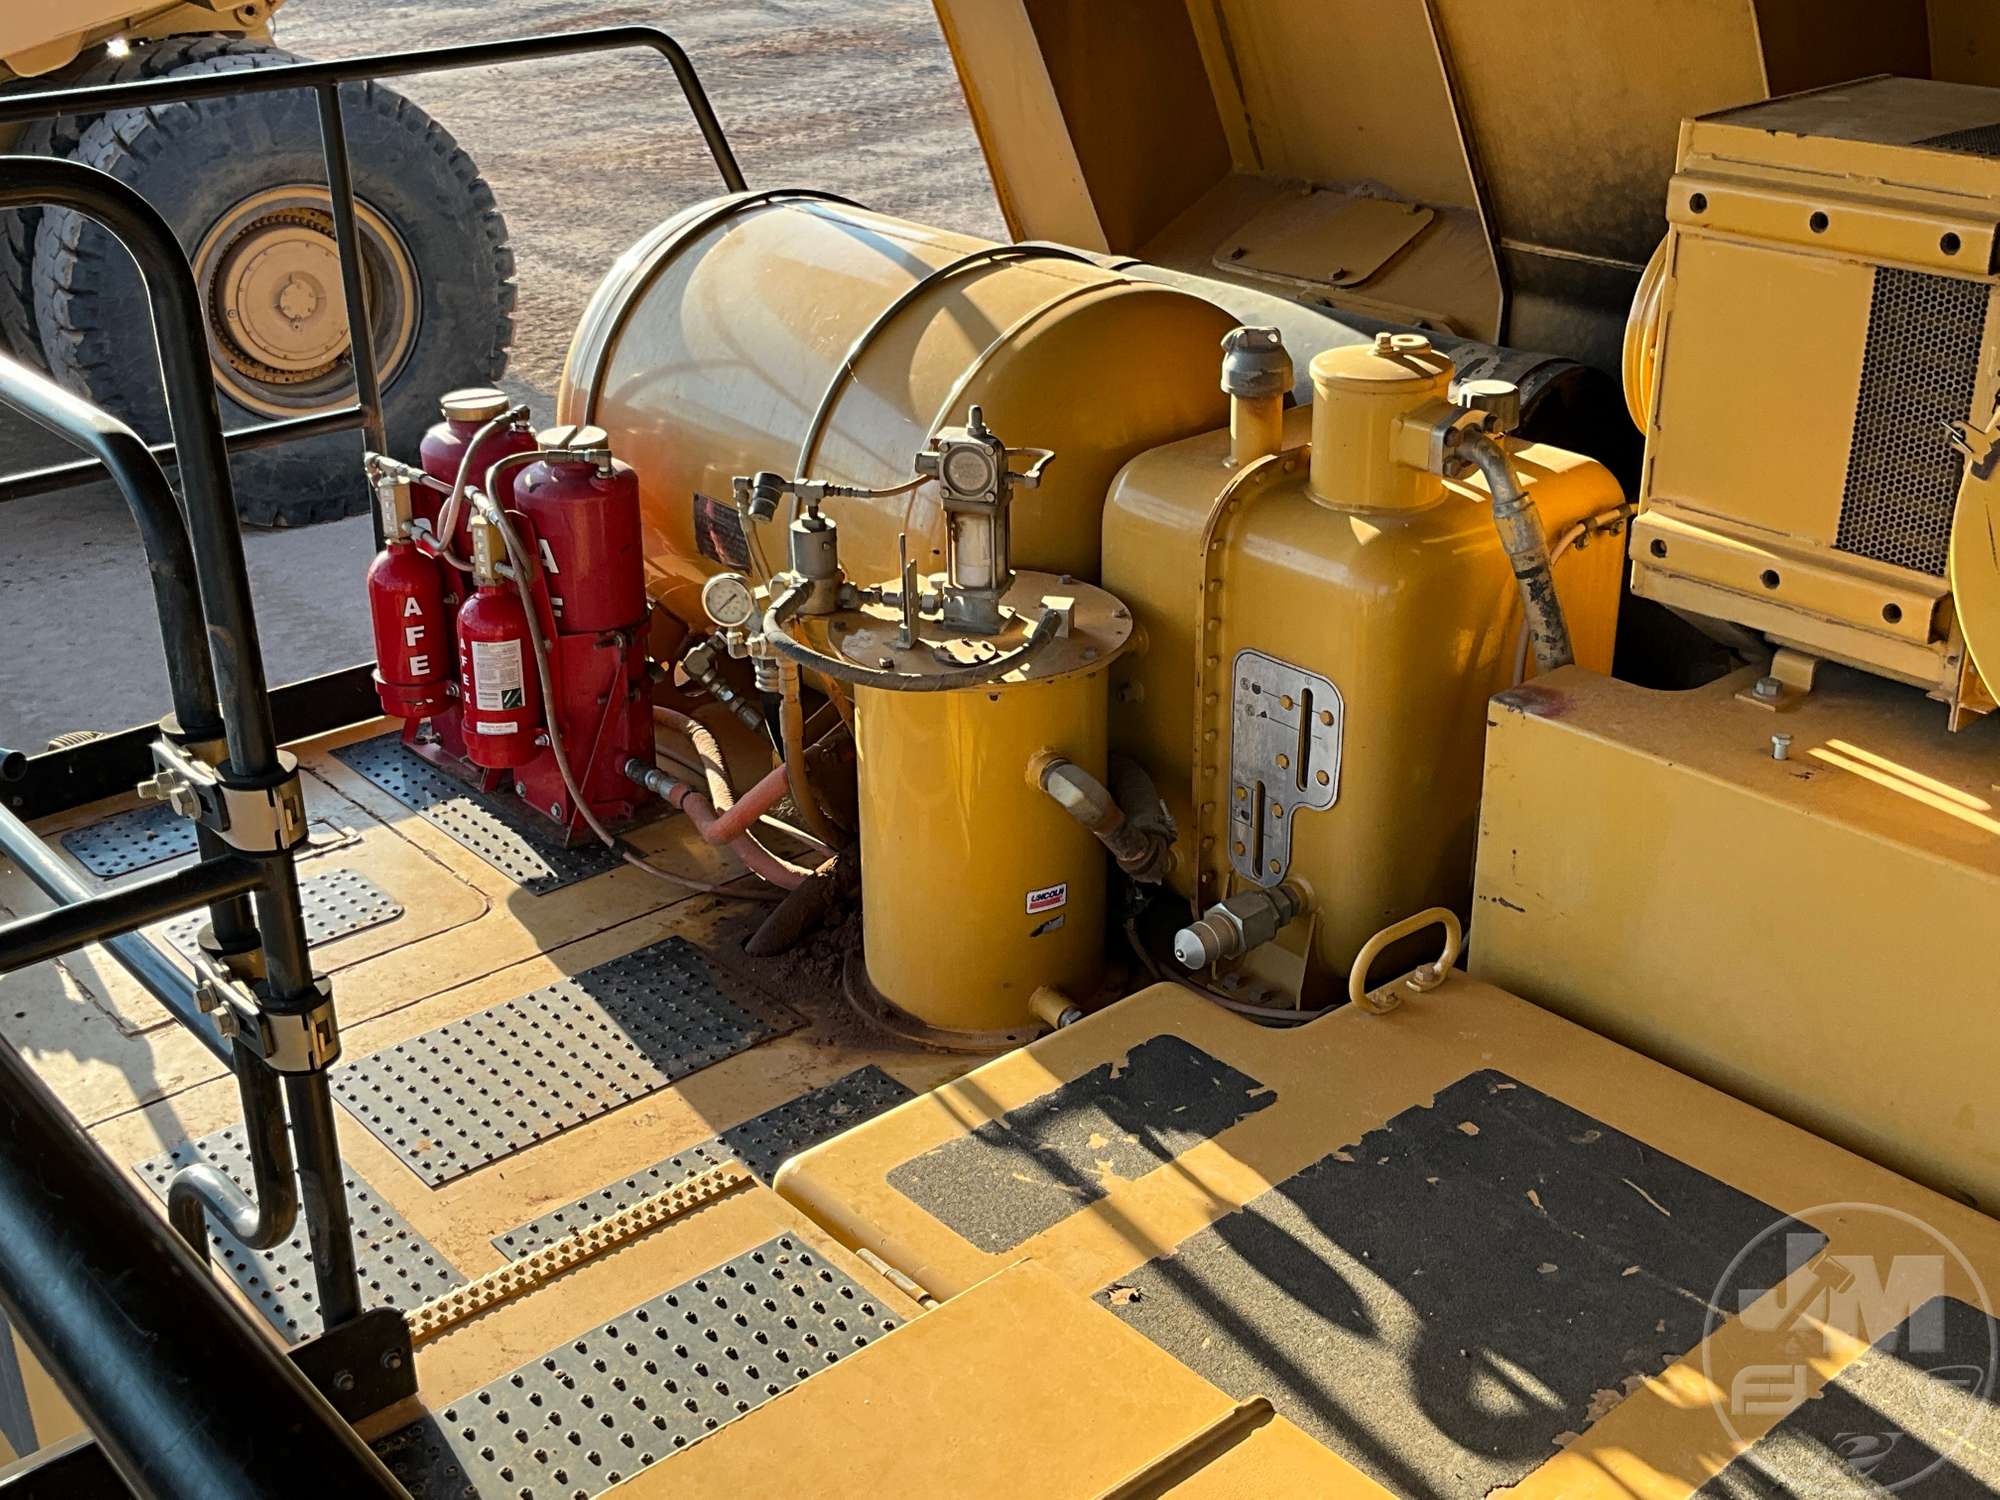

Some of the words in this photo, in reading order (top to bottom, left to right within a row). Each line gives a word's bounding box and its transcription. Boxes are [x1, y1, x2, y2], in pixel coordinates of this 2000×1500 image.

[404, 597, 434, 705] AFE
[460, 637, 471, 704] AFEX
[1031, 888, 1065, 902] LINCOLN
